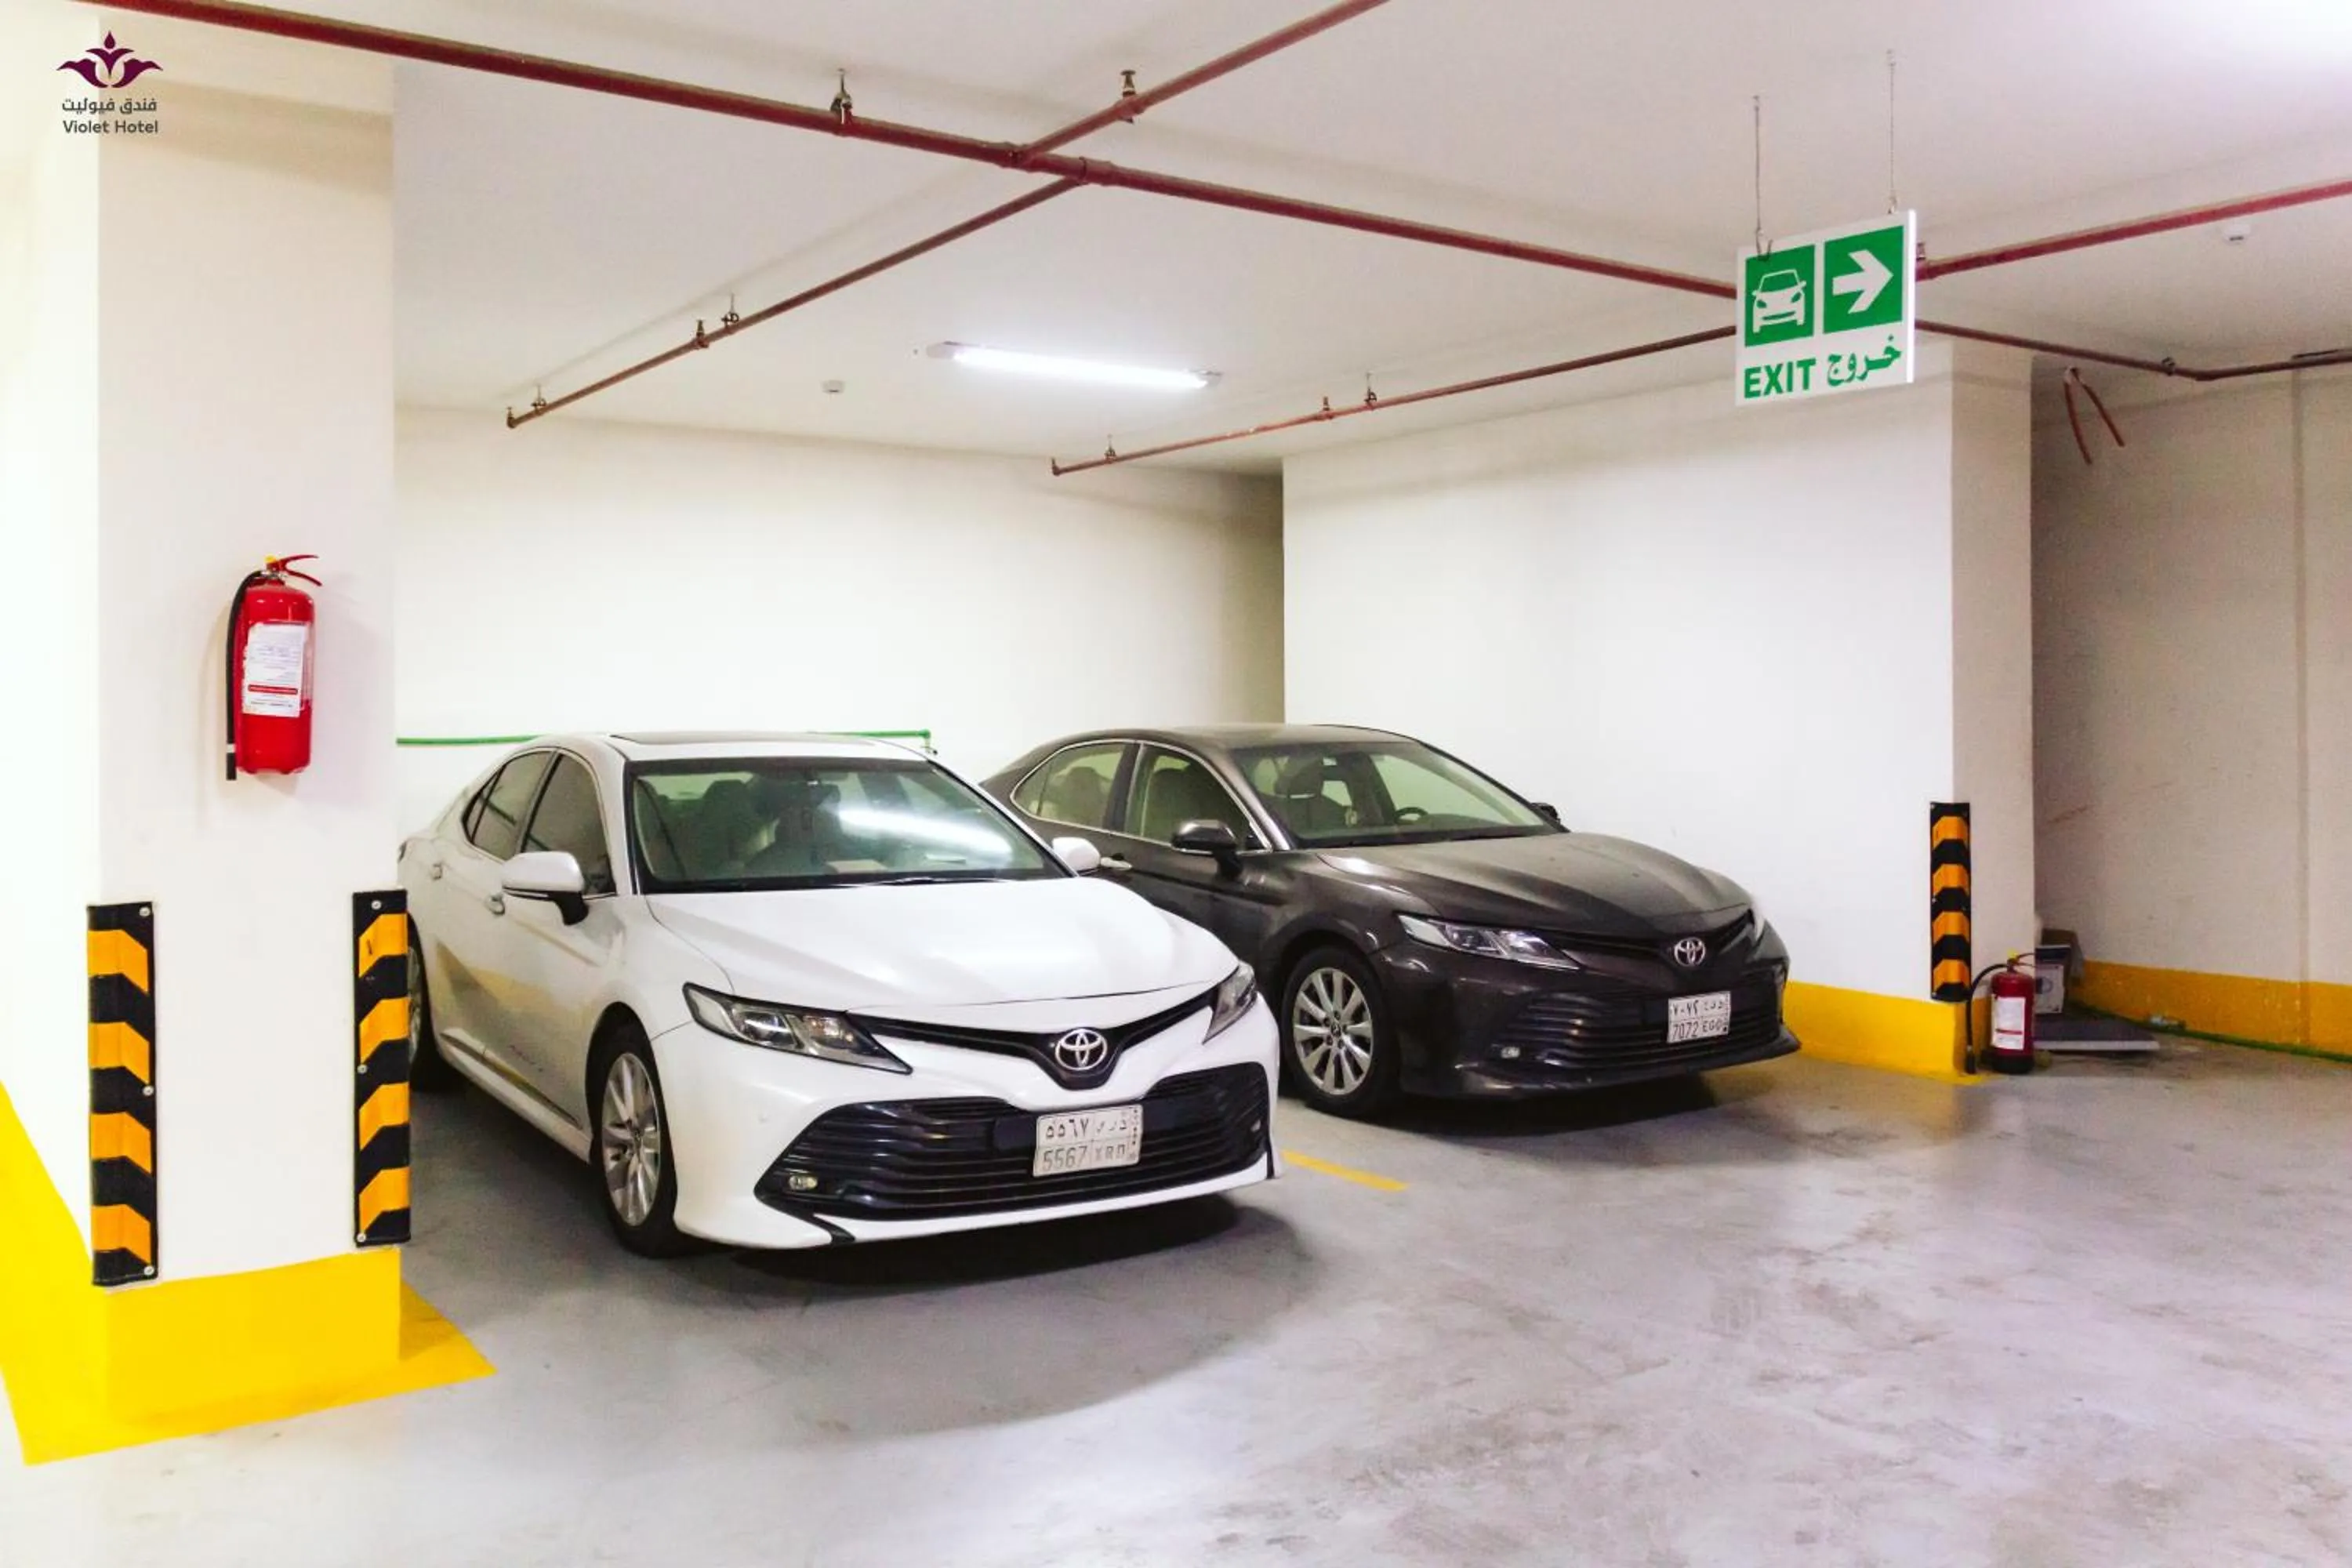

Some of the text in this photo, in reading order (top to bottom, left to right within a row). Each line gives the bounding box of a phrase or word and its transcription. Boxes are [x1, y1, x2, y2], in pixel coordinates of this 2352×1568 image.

[1744, 358, 1817, 399] EXIT
[1828, 334, 1901, 386] خروج
[1043, 1145, 1087, 1171] 5567
